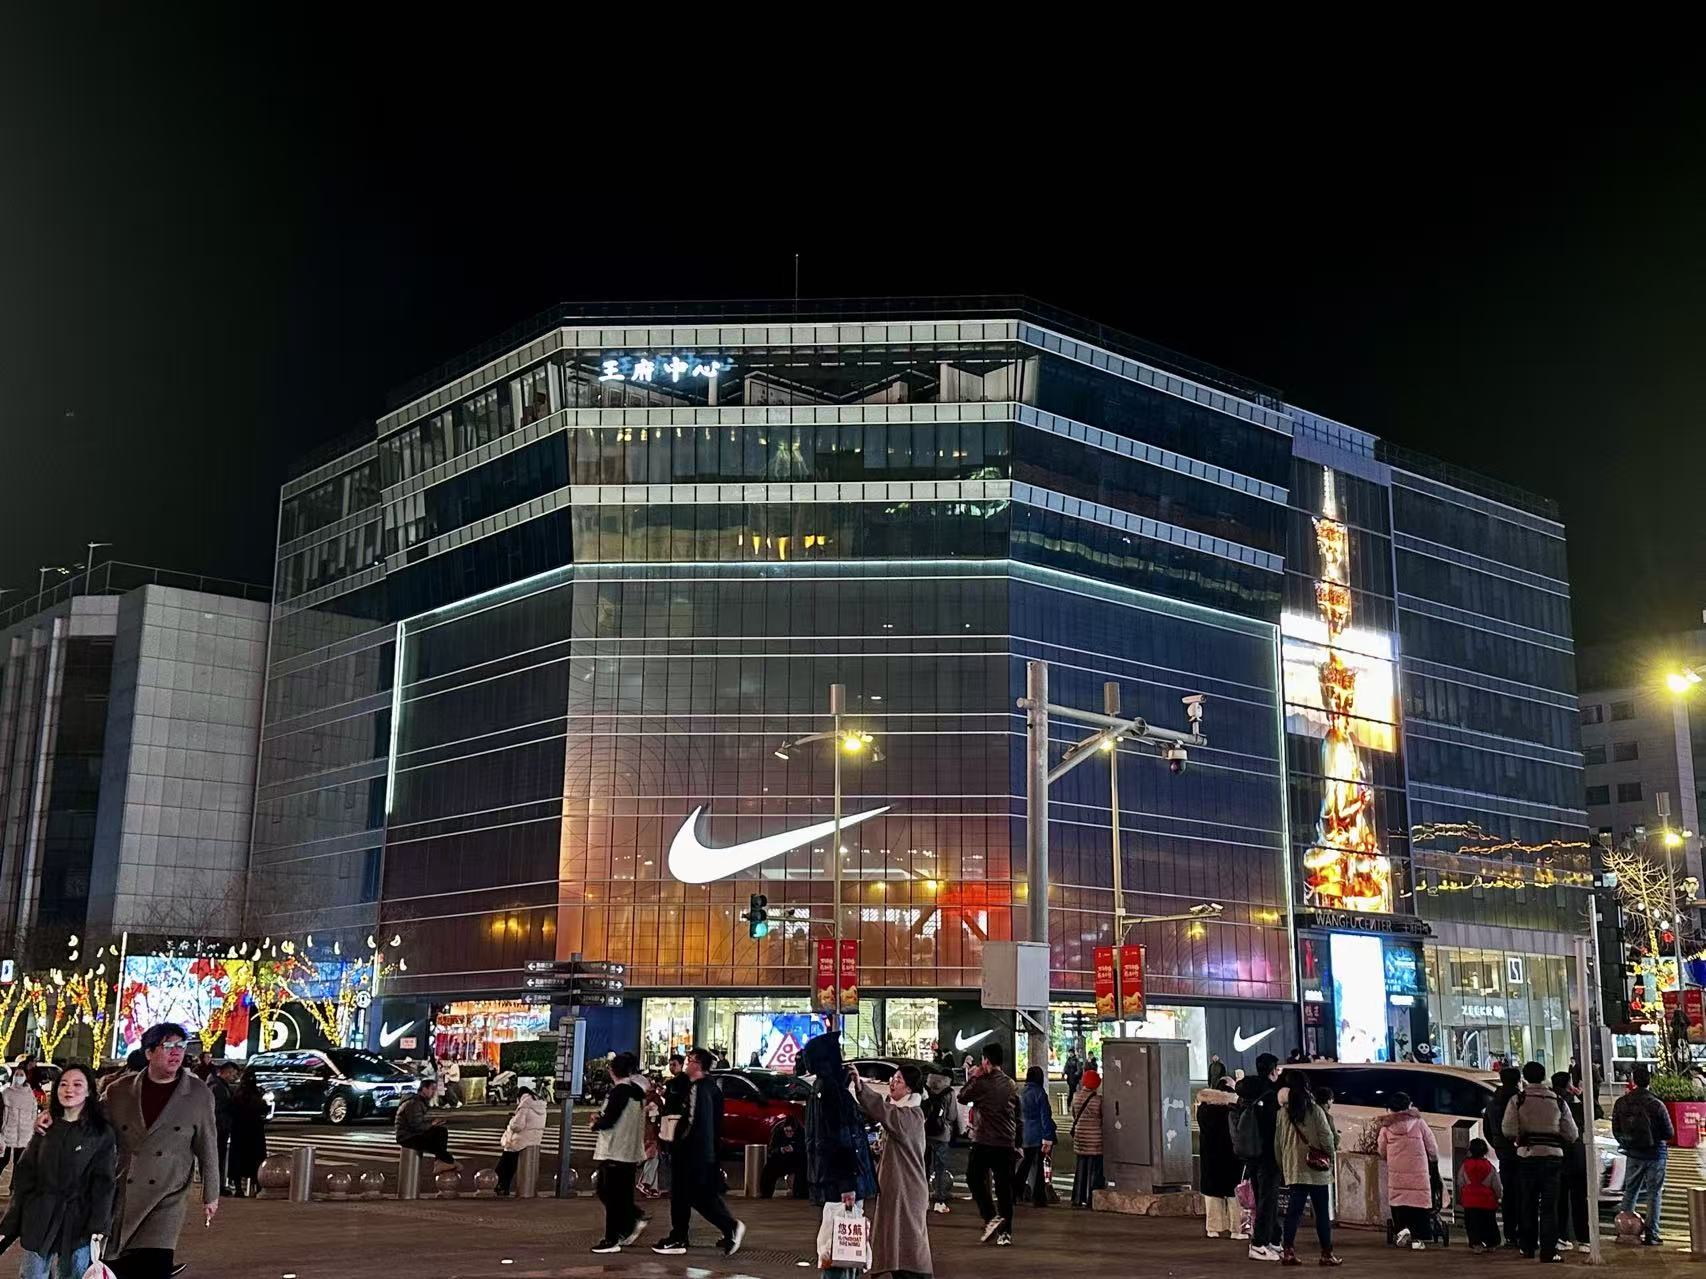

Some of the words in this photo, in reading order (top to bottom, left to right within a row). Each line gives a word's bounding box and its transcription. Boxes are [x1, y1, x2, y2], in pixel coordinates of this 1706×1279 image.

[598, 356, 721, 382] 王府中心
[1315, 911, 1357, 929] WANGFU
